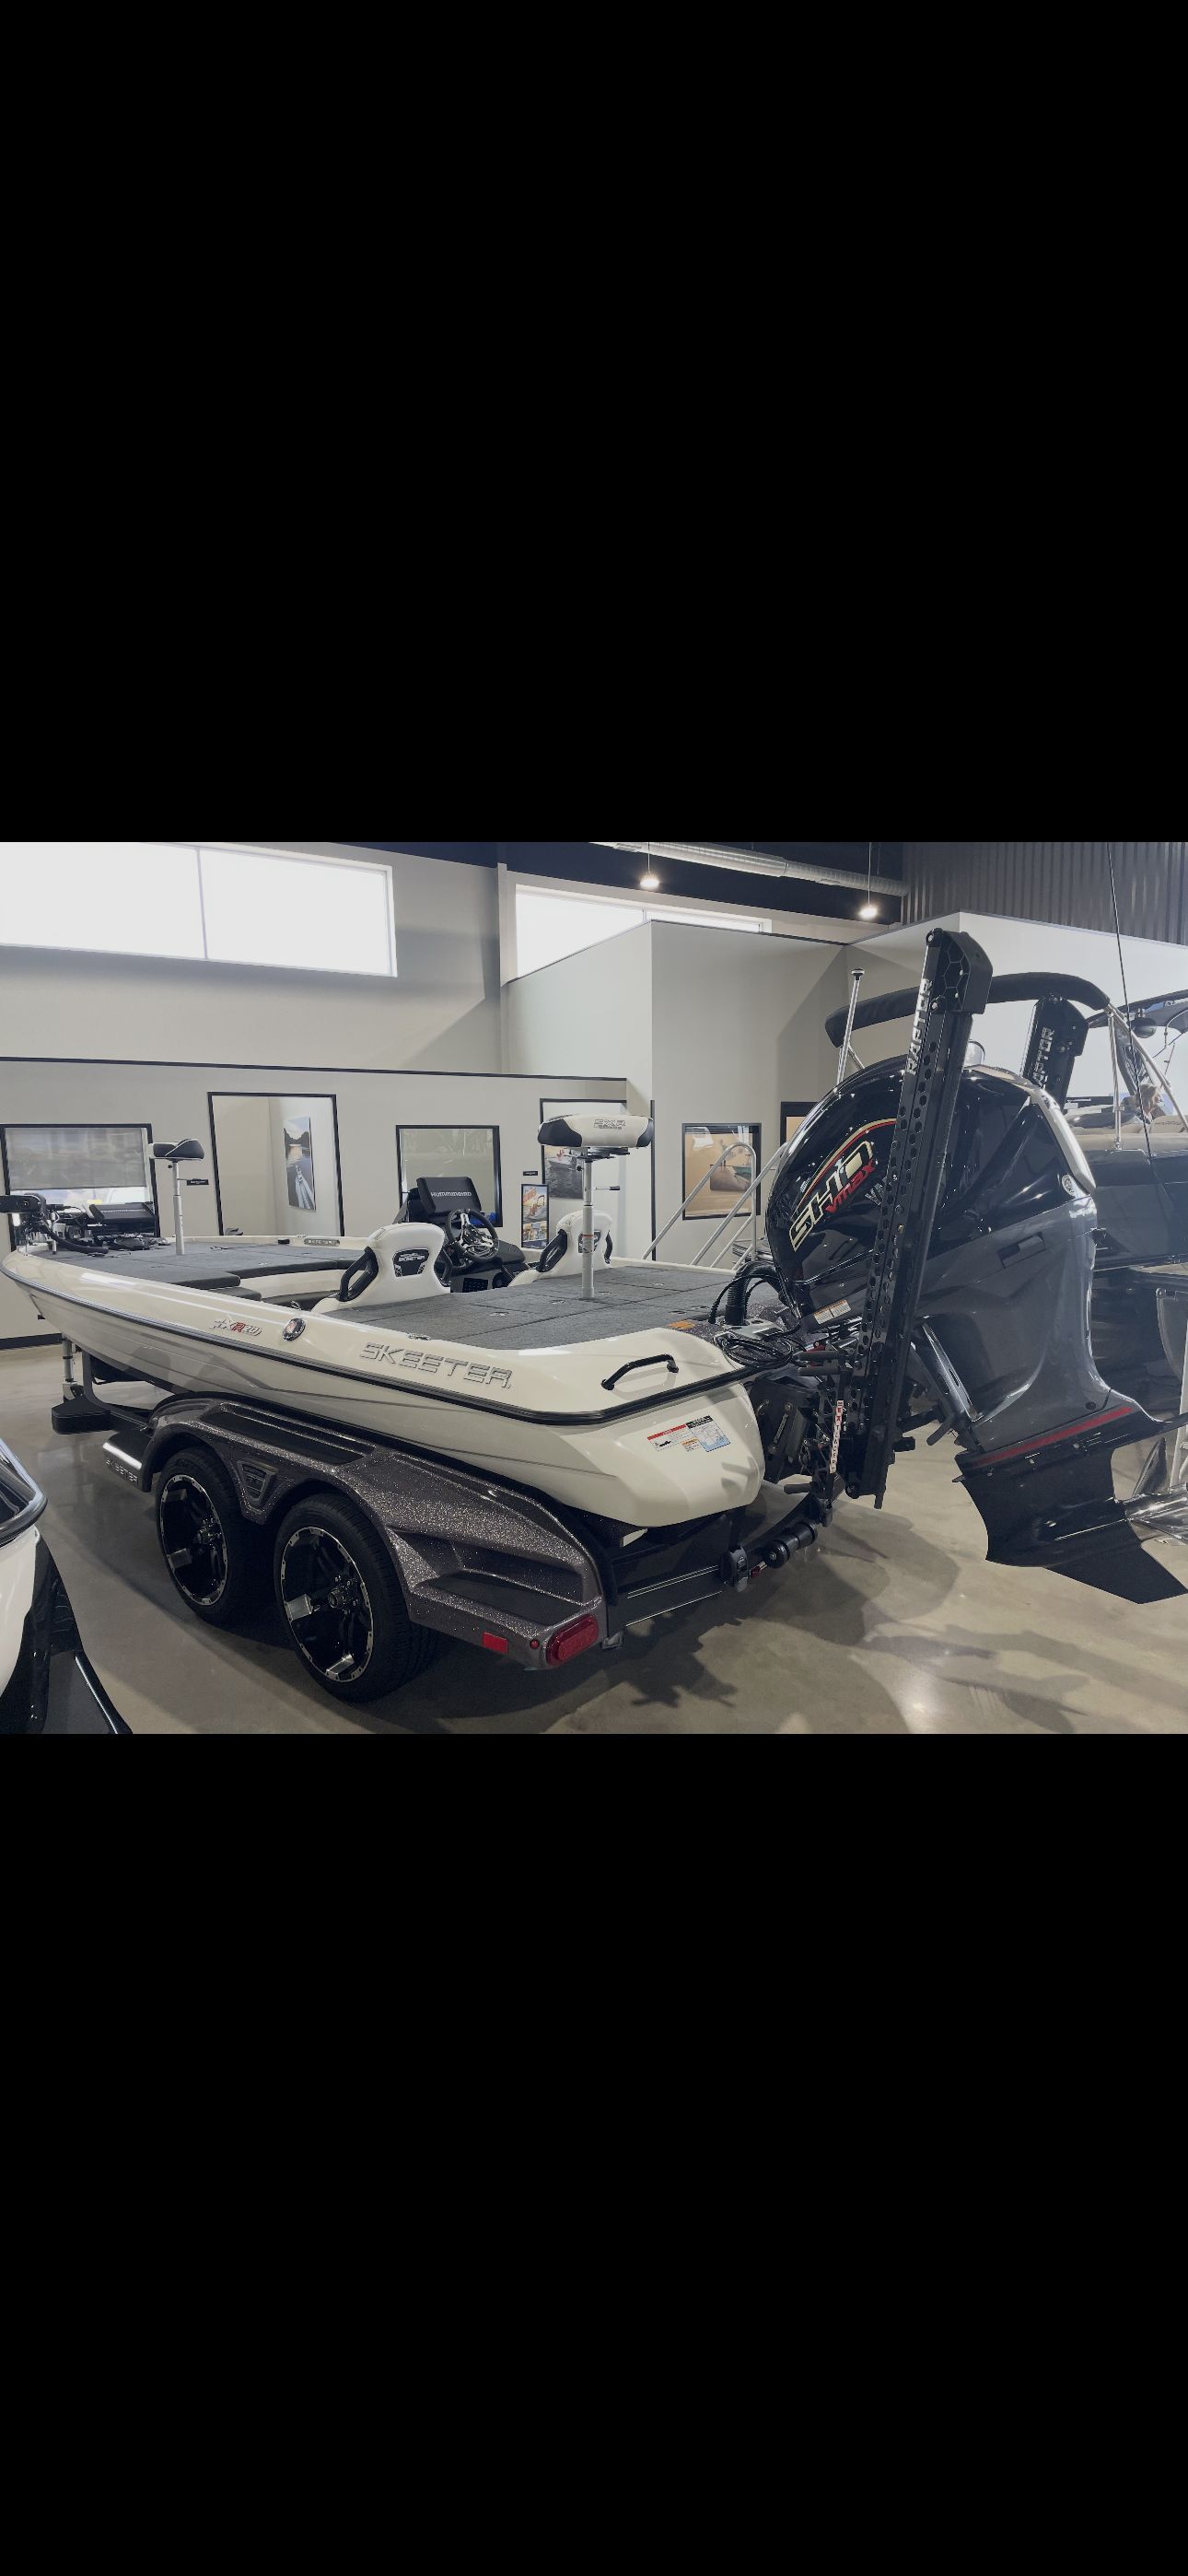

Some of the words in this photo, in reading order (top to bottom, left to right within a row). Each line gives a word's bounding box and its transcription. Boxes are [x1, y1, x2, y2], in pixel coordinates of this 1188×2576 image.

[905, 978, 932, 1076] RAPTOR
[789, 1141, 873, 1252] SHO
[360, 1341, 512, 1389] SKEETER
